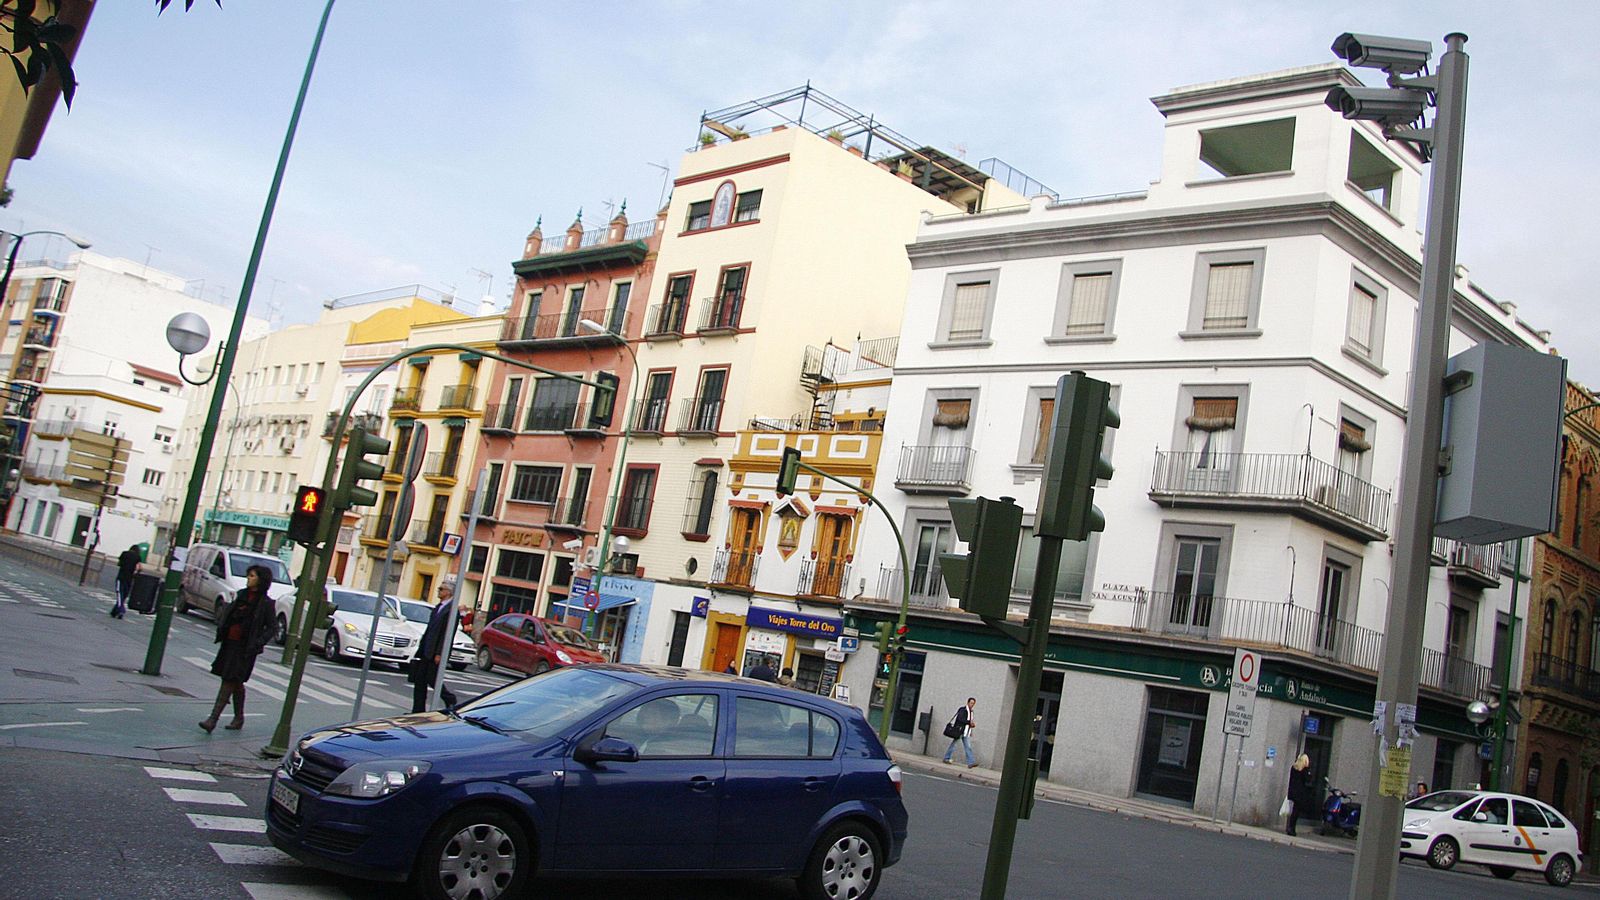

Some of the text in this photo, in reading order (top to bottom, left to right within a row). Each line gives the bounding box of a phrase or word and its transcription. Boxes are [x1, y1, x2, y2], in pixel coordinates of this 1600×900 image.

[1102, 583, 1129, 591] PLAZA
[1091, 592, 1107, 600] SAN
[768, 614, 787, 626] Viajes
[789, 617, 807, 628] Torre
[808, 620, 819, 630] del
[821, 622, 836, 632] Oro
